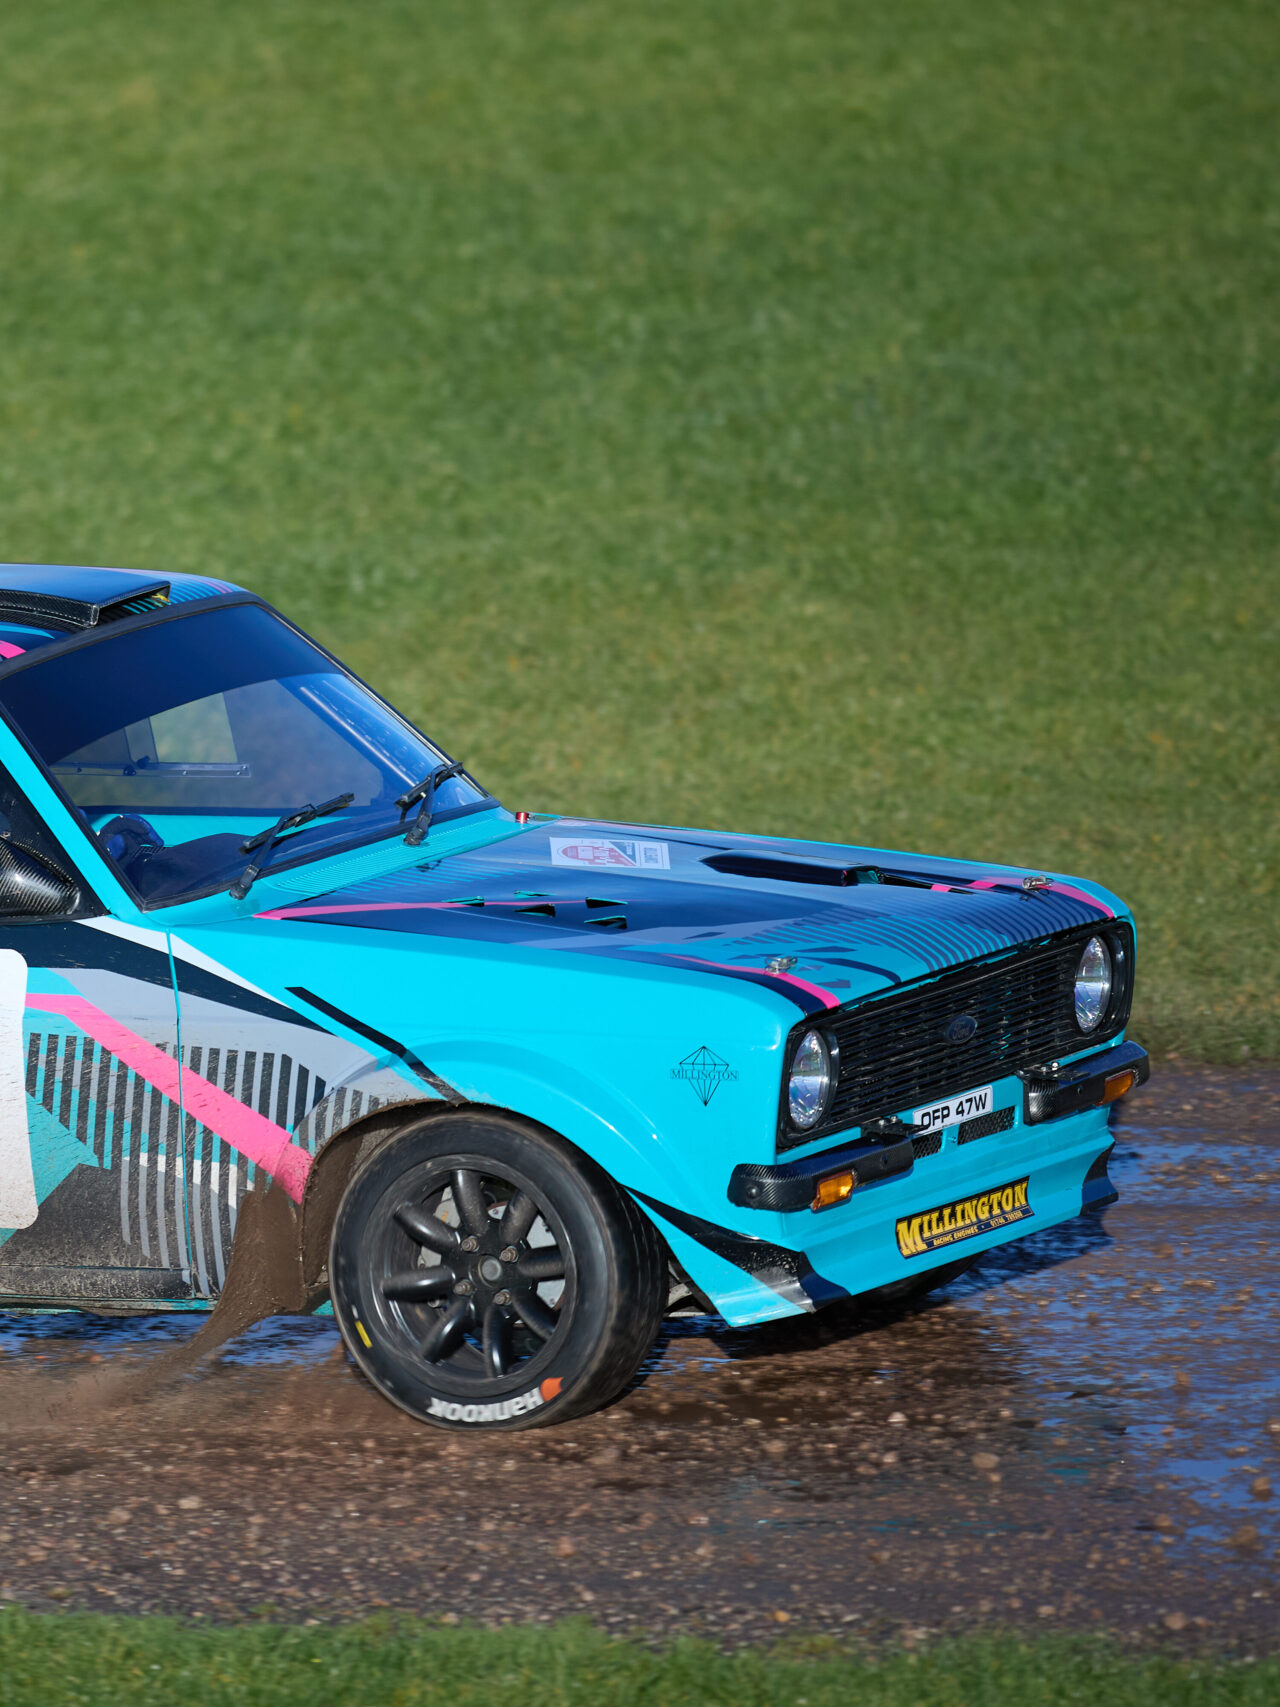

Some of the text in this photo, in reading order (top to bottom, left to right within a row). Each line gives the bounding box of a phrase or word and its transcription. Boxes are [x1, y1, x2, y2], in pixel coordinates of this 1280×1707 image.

[672, 1069, 738, 1081] MILLINGTON
[955, 1093, 987, 1117] 47W
[896, 1182, 1028, 1256] MILLINGTON
